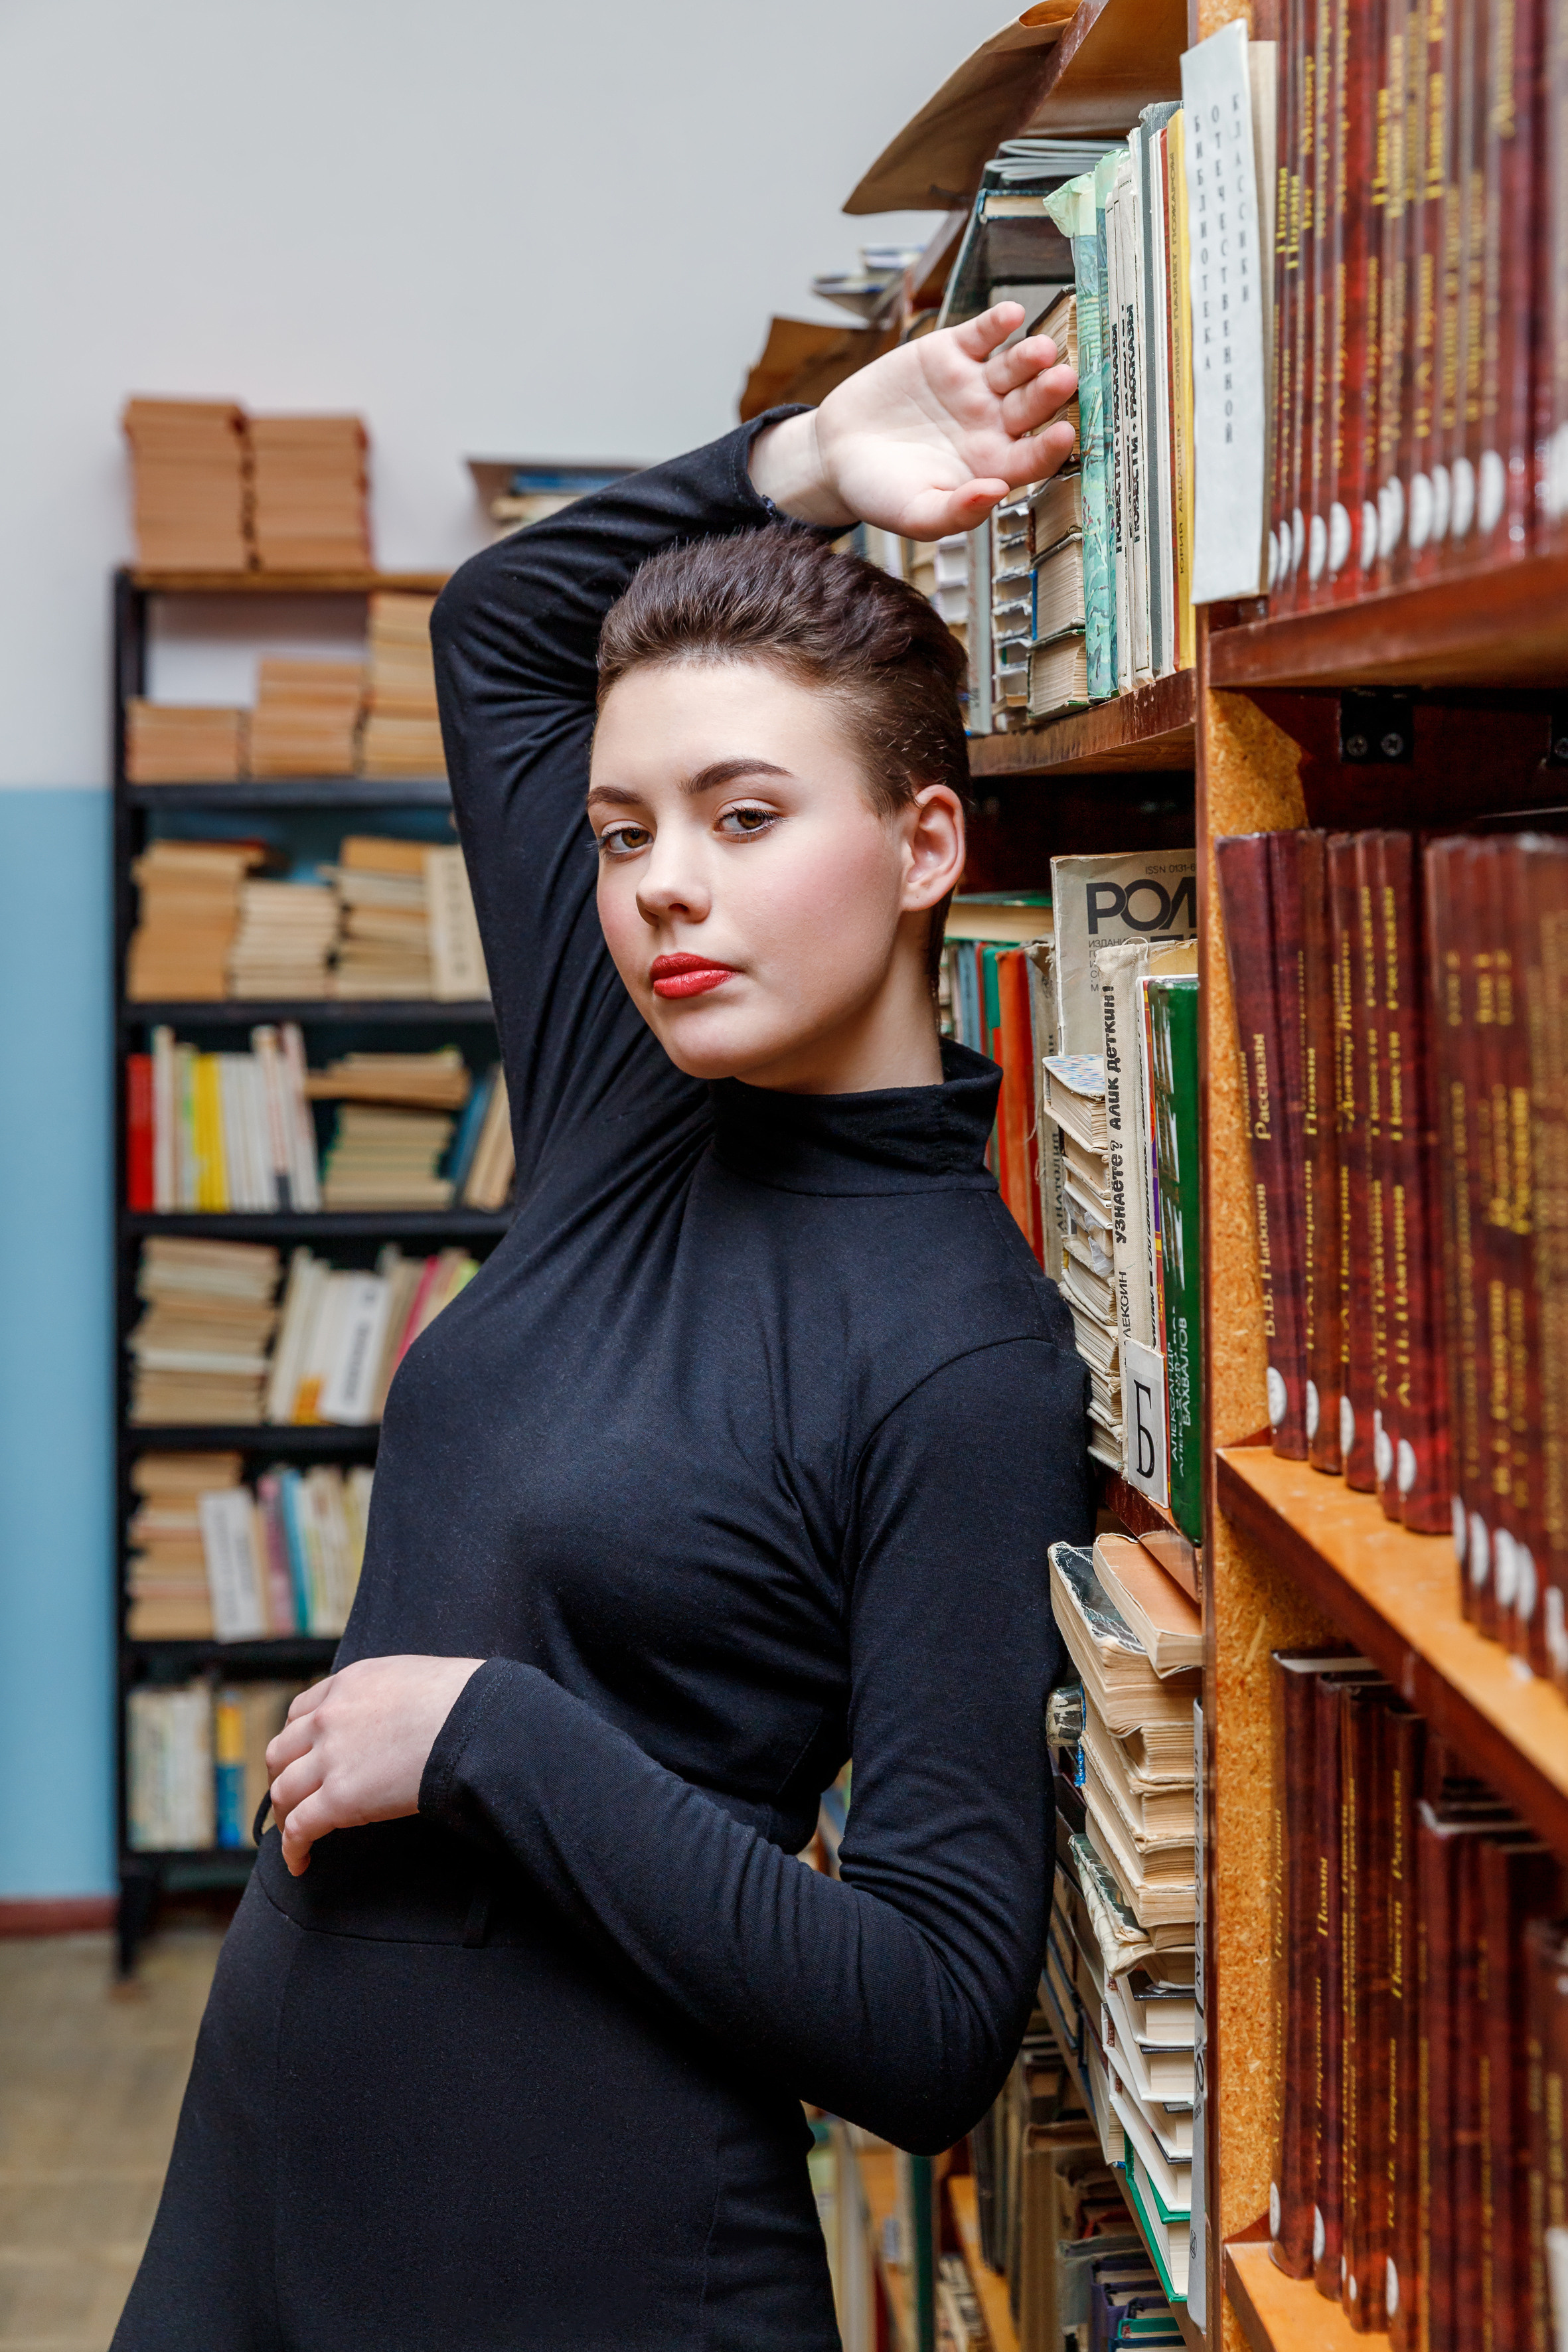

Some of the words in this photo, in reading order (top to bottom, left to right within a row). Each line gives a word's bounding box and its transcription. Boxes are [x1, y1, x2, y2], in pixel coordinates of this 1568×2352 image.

[1194, 115, 1212, 372] БИБЛИОТЕКА
[1232, 93, 1250, 303] КЛАССИКИ
[1212, 104, 1233, 445] ОТЕЧЕСТВЕННОЙ
[1111, 323, 1120, 435] РАССКАЗЫ
[1126, 304, 1137, 420] РАССКАЗЫ
[1114, 451, 1123, 554] ПОВЕСТИ
[1131, 436, 1140, 543] ПОВЕСТИ
[1146, 866, 1166, 875] ISSN
[1253, 1033, 1272, 1141] Рассказы
[1167, 1341, 1178, 1462] АЛЕКСАНДР
[1178, 1317, 1192, 1427] БАХВАЛОВ
[1134, 1379, 1156, 1480] Б
